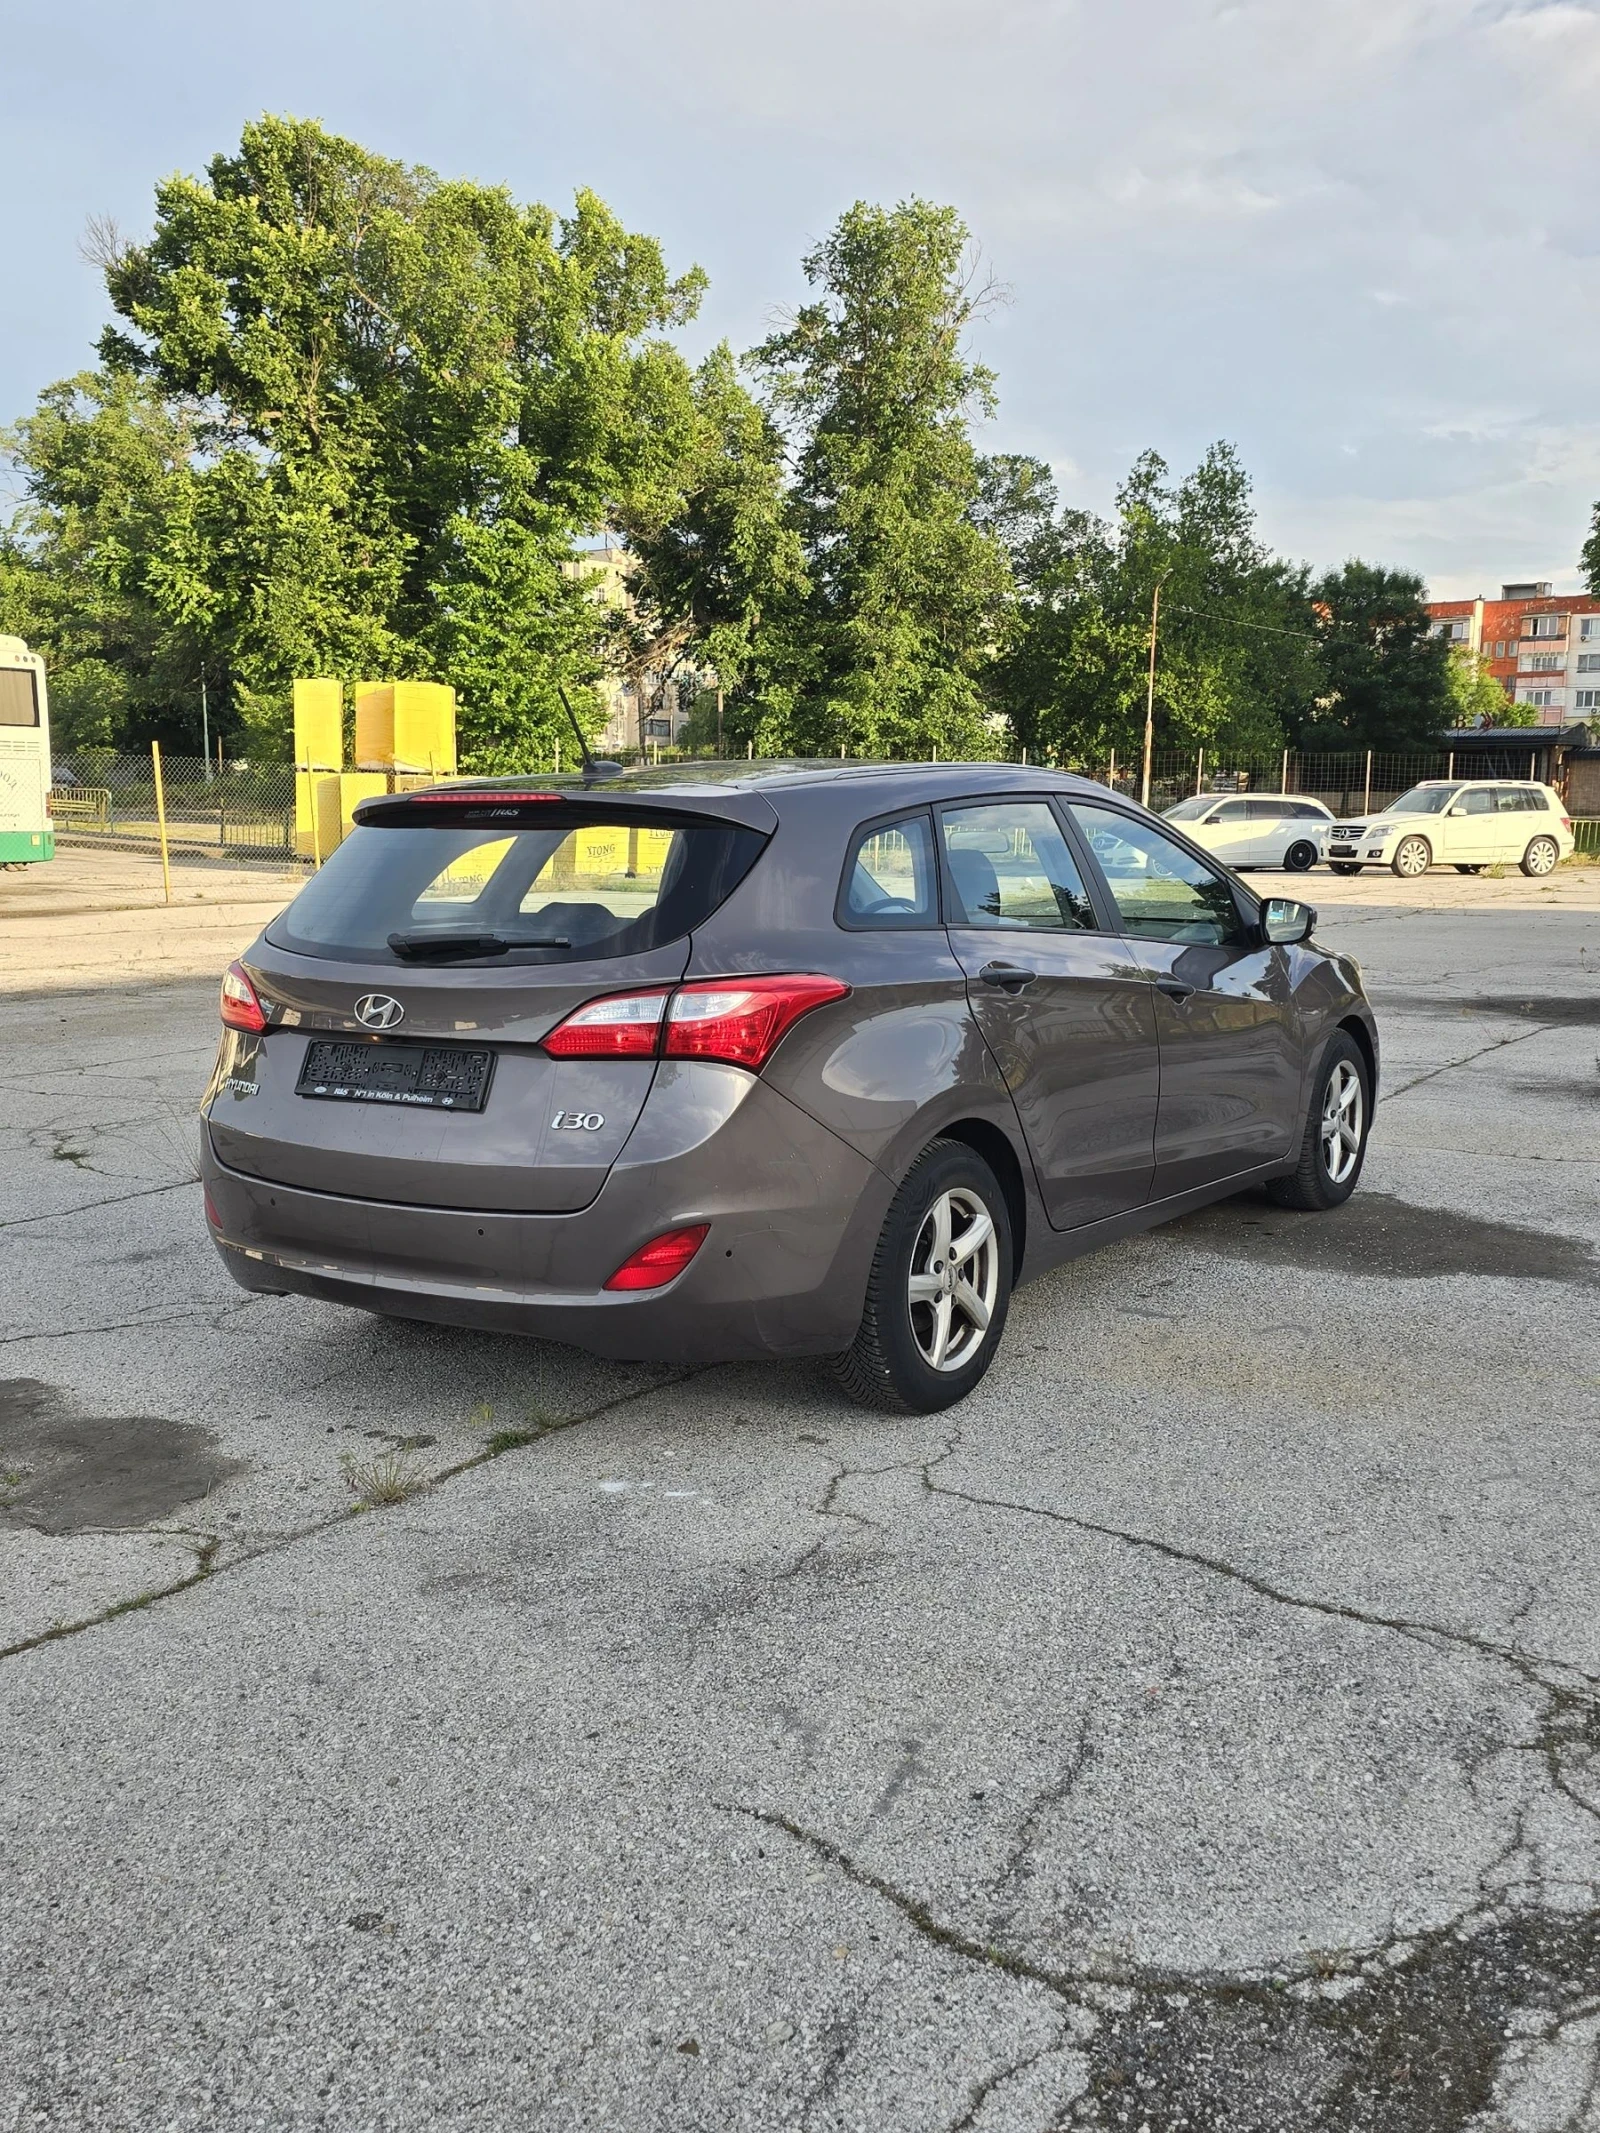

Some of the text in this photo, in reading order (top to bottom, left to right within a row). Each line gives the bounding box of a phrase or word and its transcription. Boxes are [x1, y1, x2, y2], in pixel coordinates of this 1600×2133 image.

[586, 843, 616, 856] YTONG
[225, 1077, 260, 1095] HYUNDAI
[367, 1090, 375, 1098] in
[376, 1091, 394, 1099] Köln
[402, 1093, 434, 1103] Pulheim
[551, 1110, 605, 1131] i30
